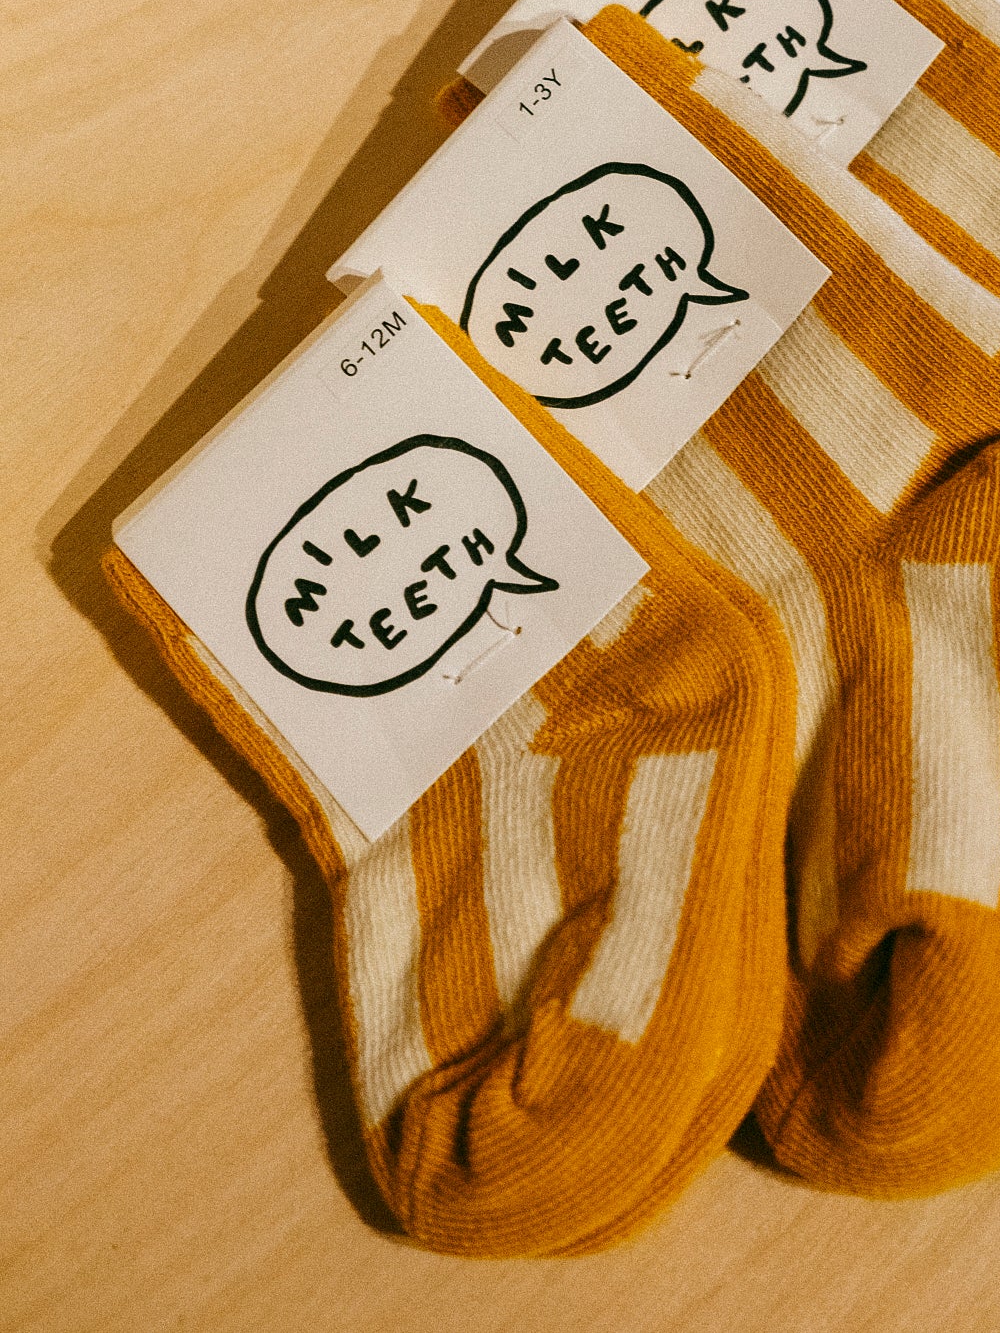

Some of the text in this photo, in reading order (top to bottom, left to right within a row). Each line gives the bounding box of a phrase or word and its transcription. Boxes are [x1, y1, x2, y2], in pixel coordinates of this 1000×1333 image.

[519, 68, 562, 116] 1-3Y
[495, 204, 625, 348] MILK
[540, 246, 687, 365] TEETH
[340, 311, 407, 377] 6-12M
[284, 479, 432, 627] MILK
[330, 528, 494, 650] TEETH
